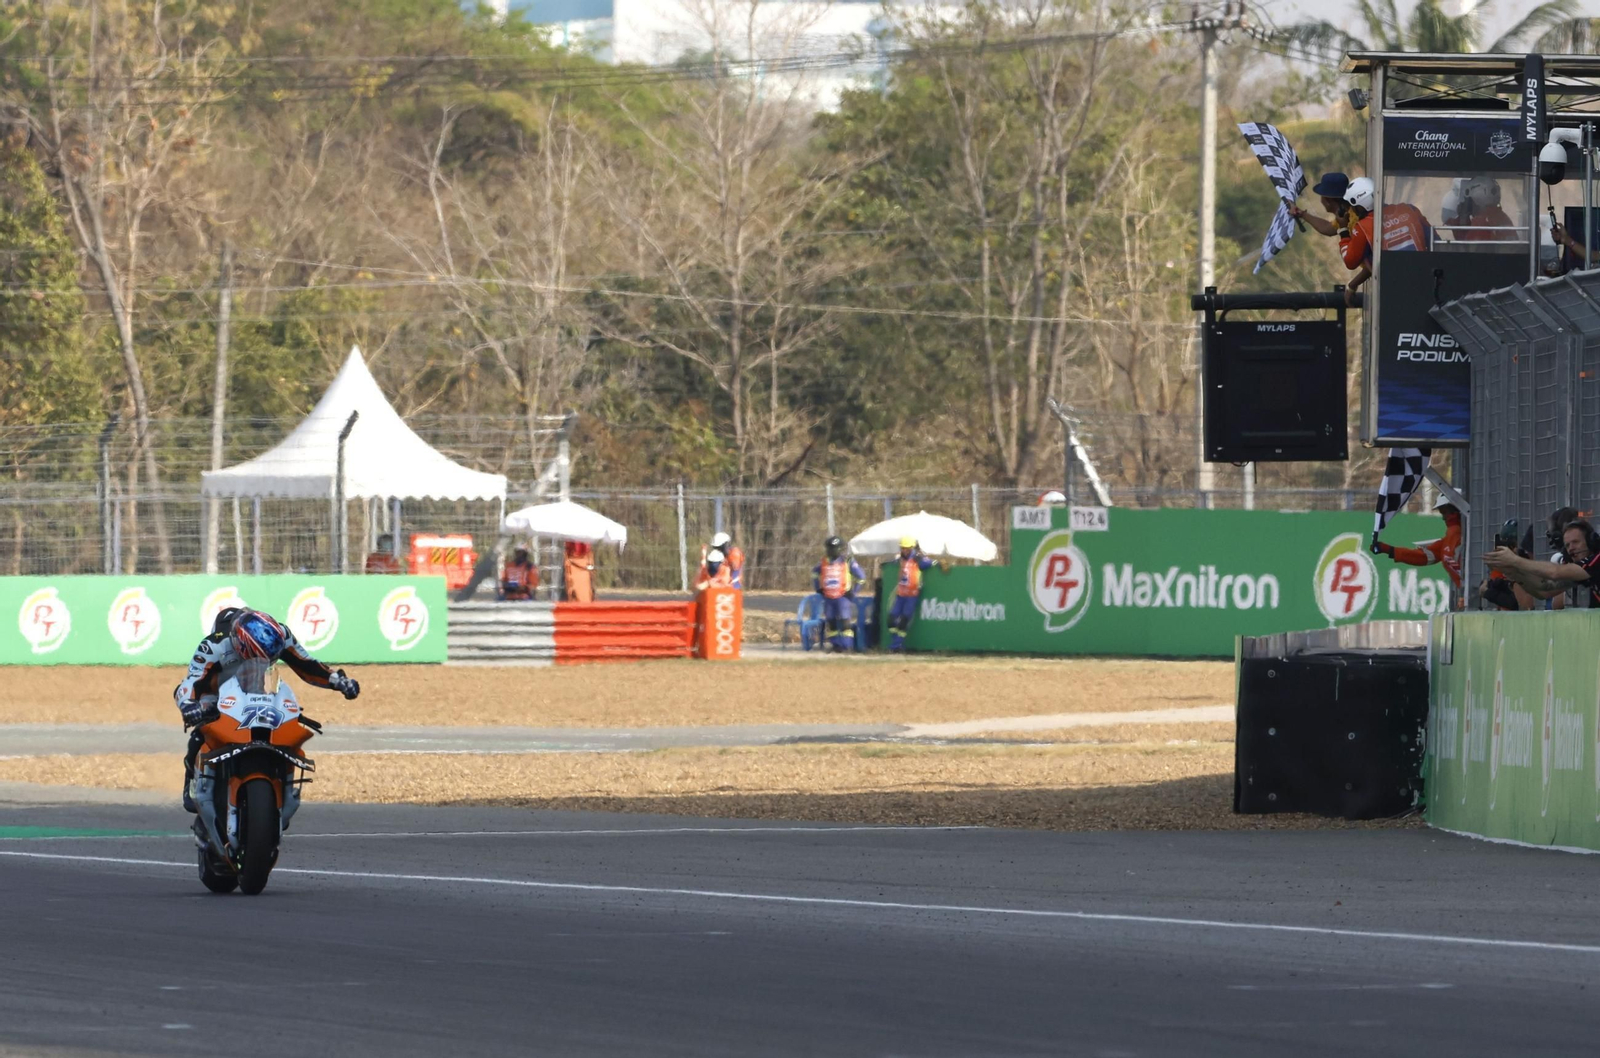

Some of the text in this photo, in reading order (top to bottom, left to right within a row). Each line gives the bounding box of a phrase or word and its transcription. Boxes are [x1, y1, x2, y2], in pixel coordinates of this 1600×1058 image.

[1526, 77, 1538, 140] MYLAPS
[1414, 129, 1449, 143] Chang
[1397, 142, 1467, 150] INTERNATIONAL
[1414, 150, 1450, 158] CIRCUIT
[1257, 324, 1296, 332] MYLAPS
[1397, 333, 1460, 348] FINIS
[1396, 350, 1472, 363] PODIUM
[1102, 562, 1279, 610] Maxnitron
[921, 597, 1006, 621] Maxnitron
[715, 592, 736, 656] DOCTOR
